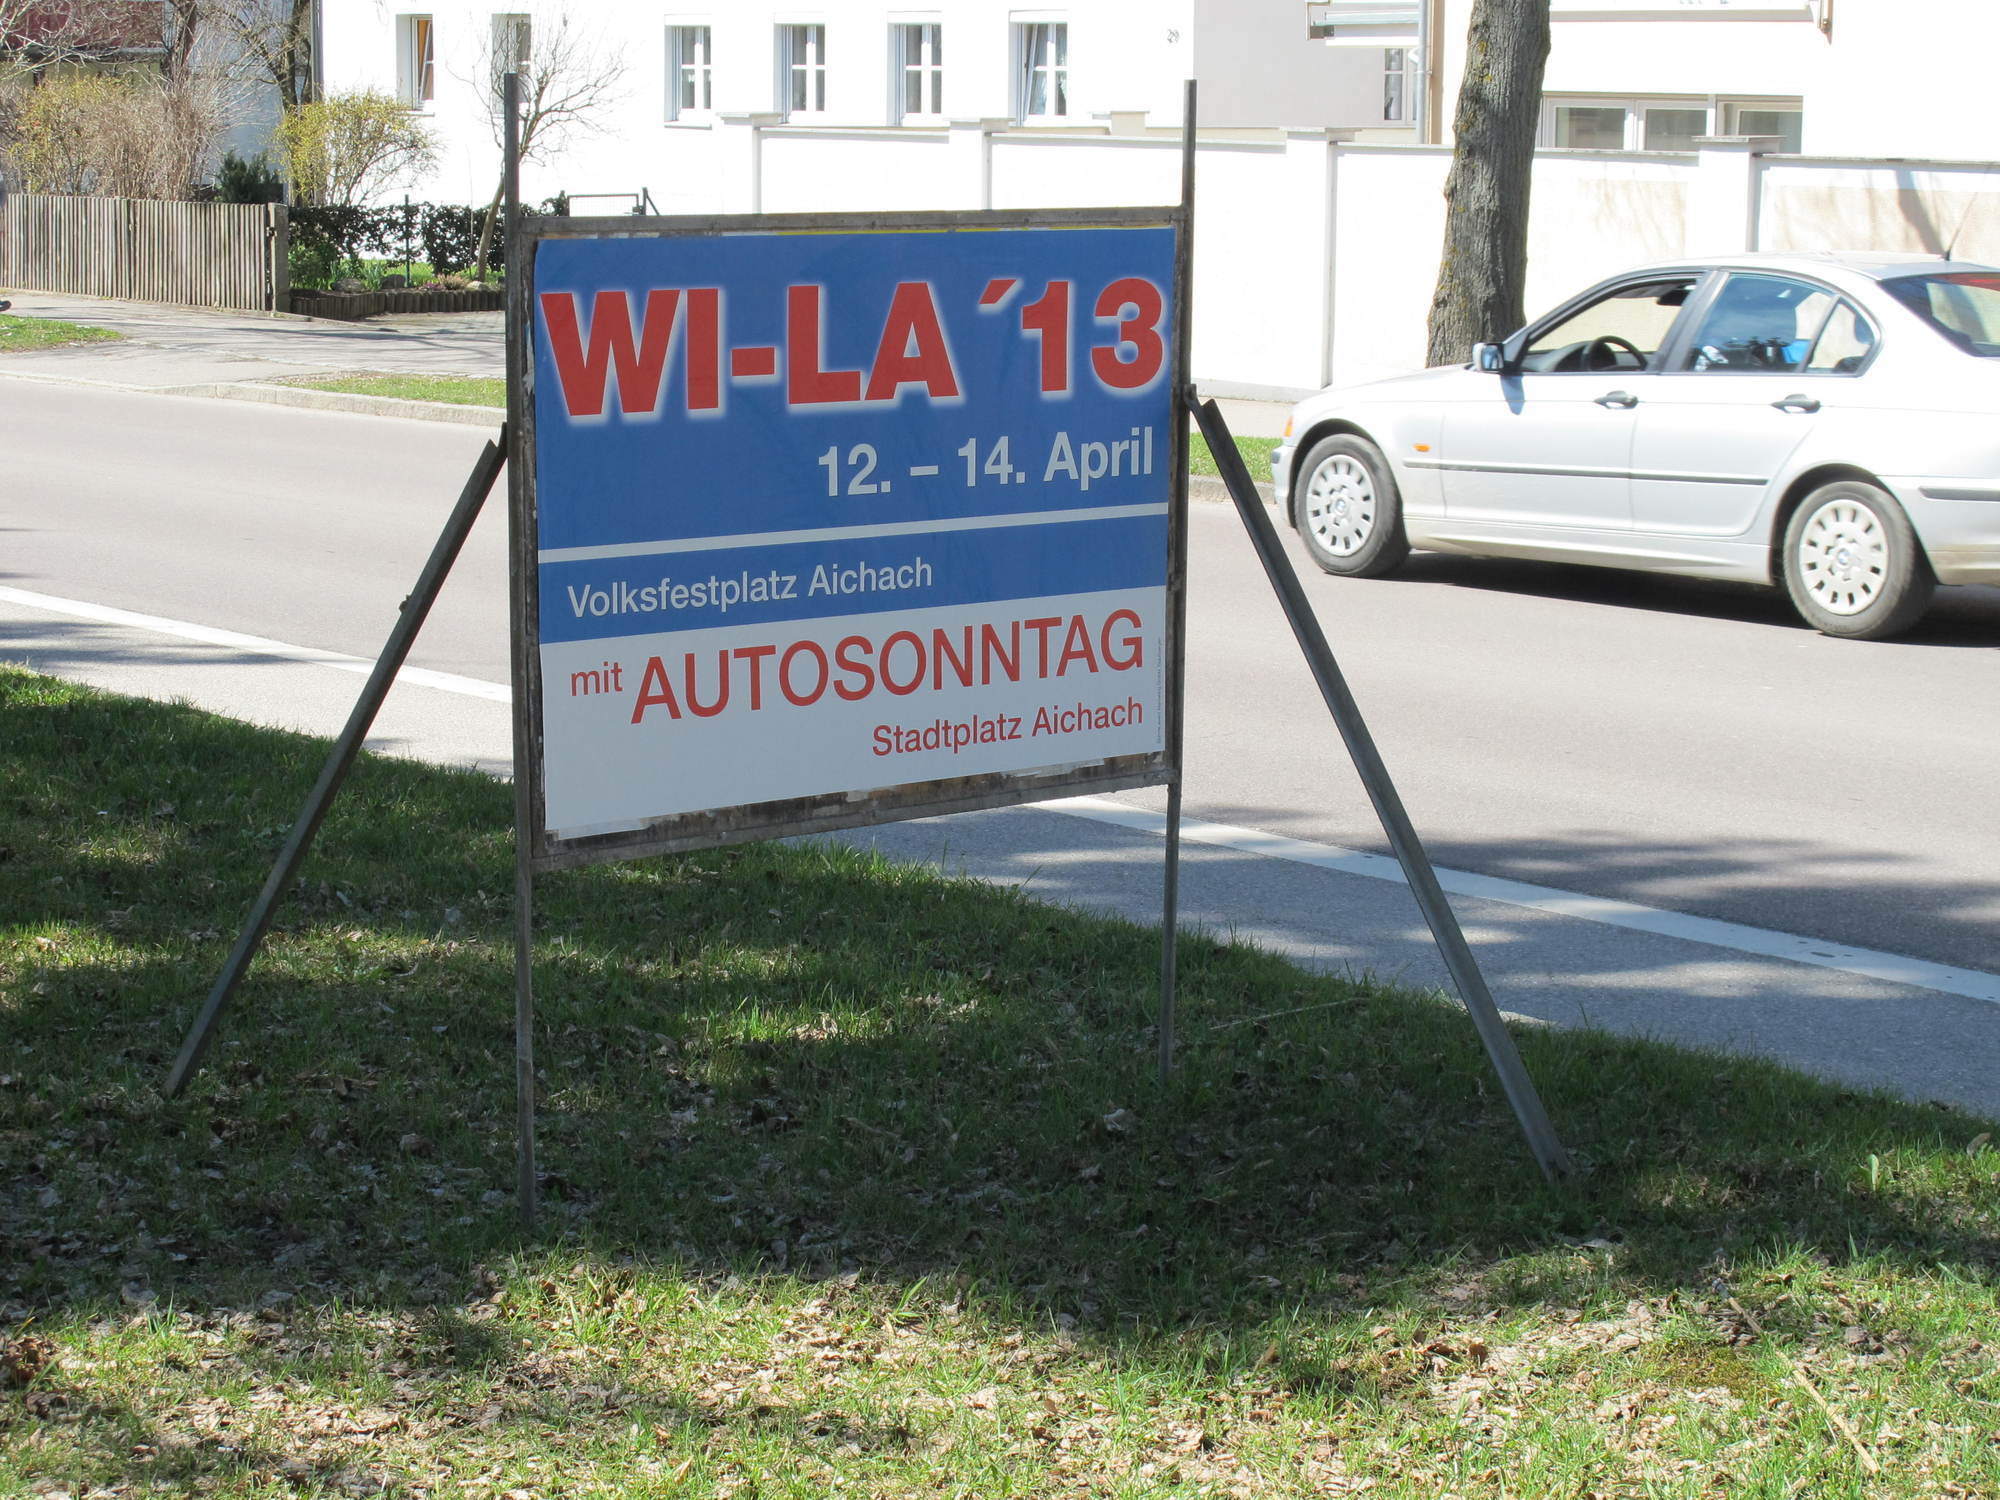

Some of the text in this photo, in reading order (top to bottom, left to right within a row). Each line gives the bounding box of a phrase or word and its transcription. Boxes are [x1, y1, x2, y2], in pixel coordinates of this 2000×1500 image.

[540, 282, 961, 417] WI-LA
[818, 443, 892, 497] 12.
[957, 435, 1027, 487] 14.
[1043, 426, 1153, 491] April
[567, 556, 933, 618] Volksfestplatz Aichach
[570, 662, 623, 697] mit
[630, 608, 1144, 725] AUTOSONNTAG
[872, 696, 1143, 757] Stadtplatz Aichach
